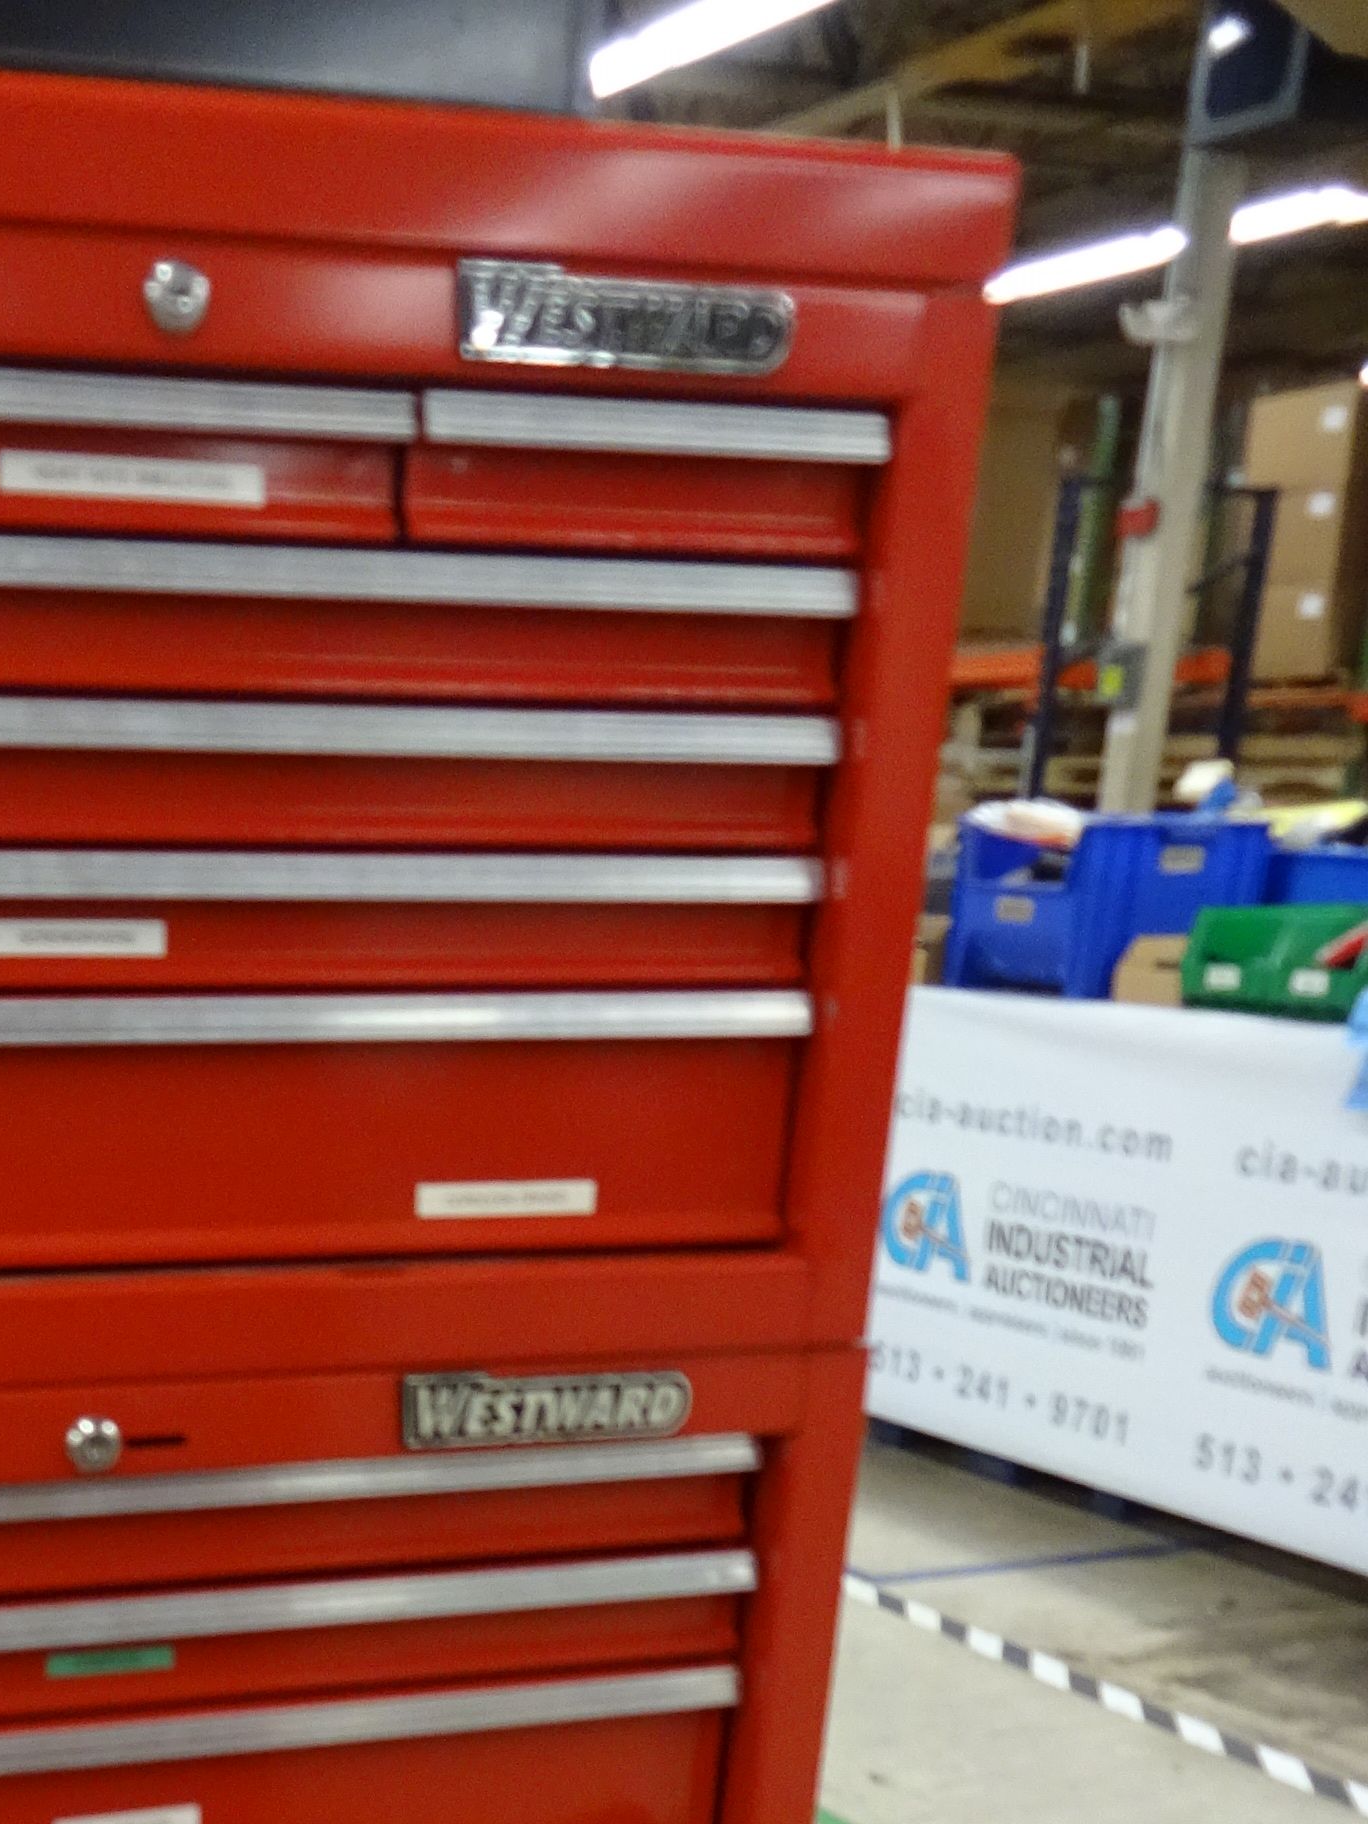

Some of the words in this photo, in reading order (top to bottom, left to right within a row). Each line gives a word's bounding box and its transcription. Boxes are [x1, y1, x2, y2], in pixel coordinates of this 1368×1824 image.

[894, 1087, 1173, 1162] cia-auction.com
[990, 1180, 1156, 1241] CINCINNATI
[986, 1218, 1153, 1289] INDUSTRIAL
[984, 1264, 1148, 1330] AUCTIONEERS
[416, 1384, 681, 1440] WESTWARD
[955, 1364, 1009, 1408] 241
[1051, 1393, 1128, 1446] 9701
[1195, 1432, 1262, 1485] 513
[1311, 1464, 1368, 1511] 24
